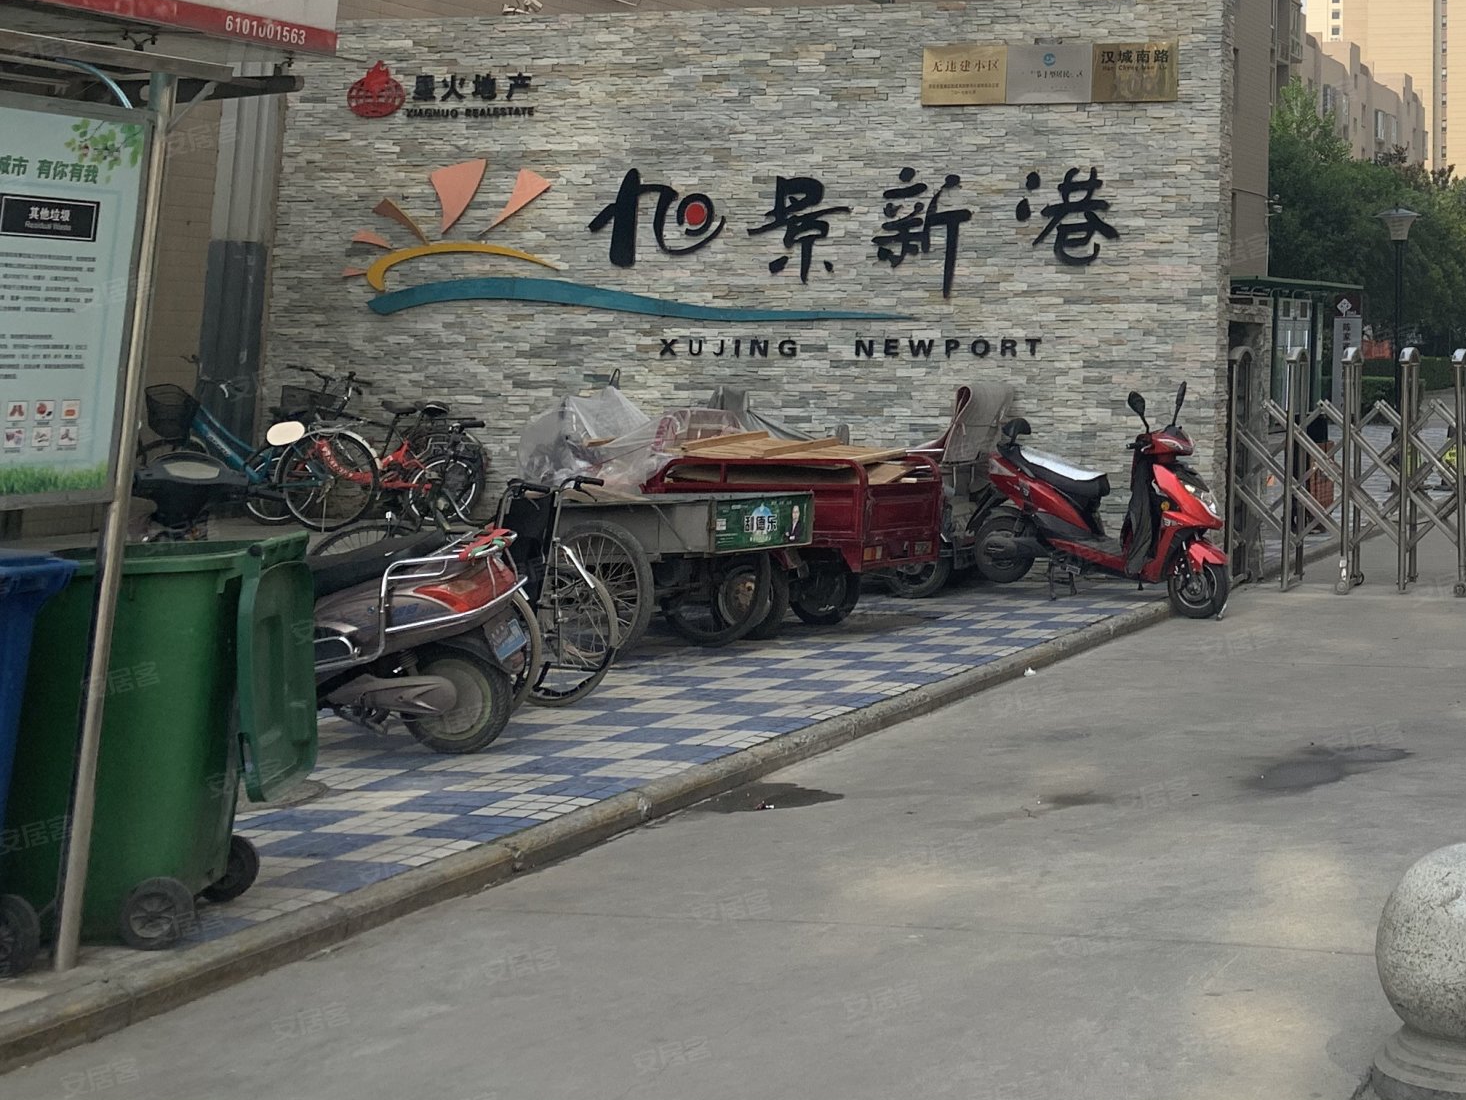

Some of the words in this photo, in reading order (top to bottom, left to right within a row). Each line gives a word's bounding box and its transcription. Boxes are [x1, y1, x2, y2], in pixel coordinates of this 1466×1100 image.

[932, 59, 1000, 73] 无违建小区
[1101, 48, 1170, 64] 汉城南路
[412, 71, 533, 102] 星火地产
[37, 159, 99, 185] 有你有我
[28, 206, 71, 222] 其他垃圾
[588, 166, 1121, 299] 旭景新港
[659, 337, 799, 360] XUJING
[854, 337, 1044, 359] NEWPORT
